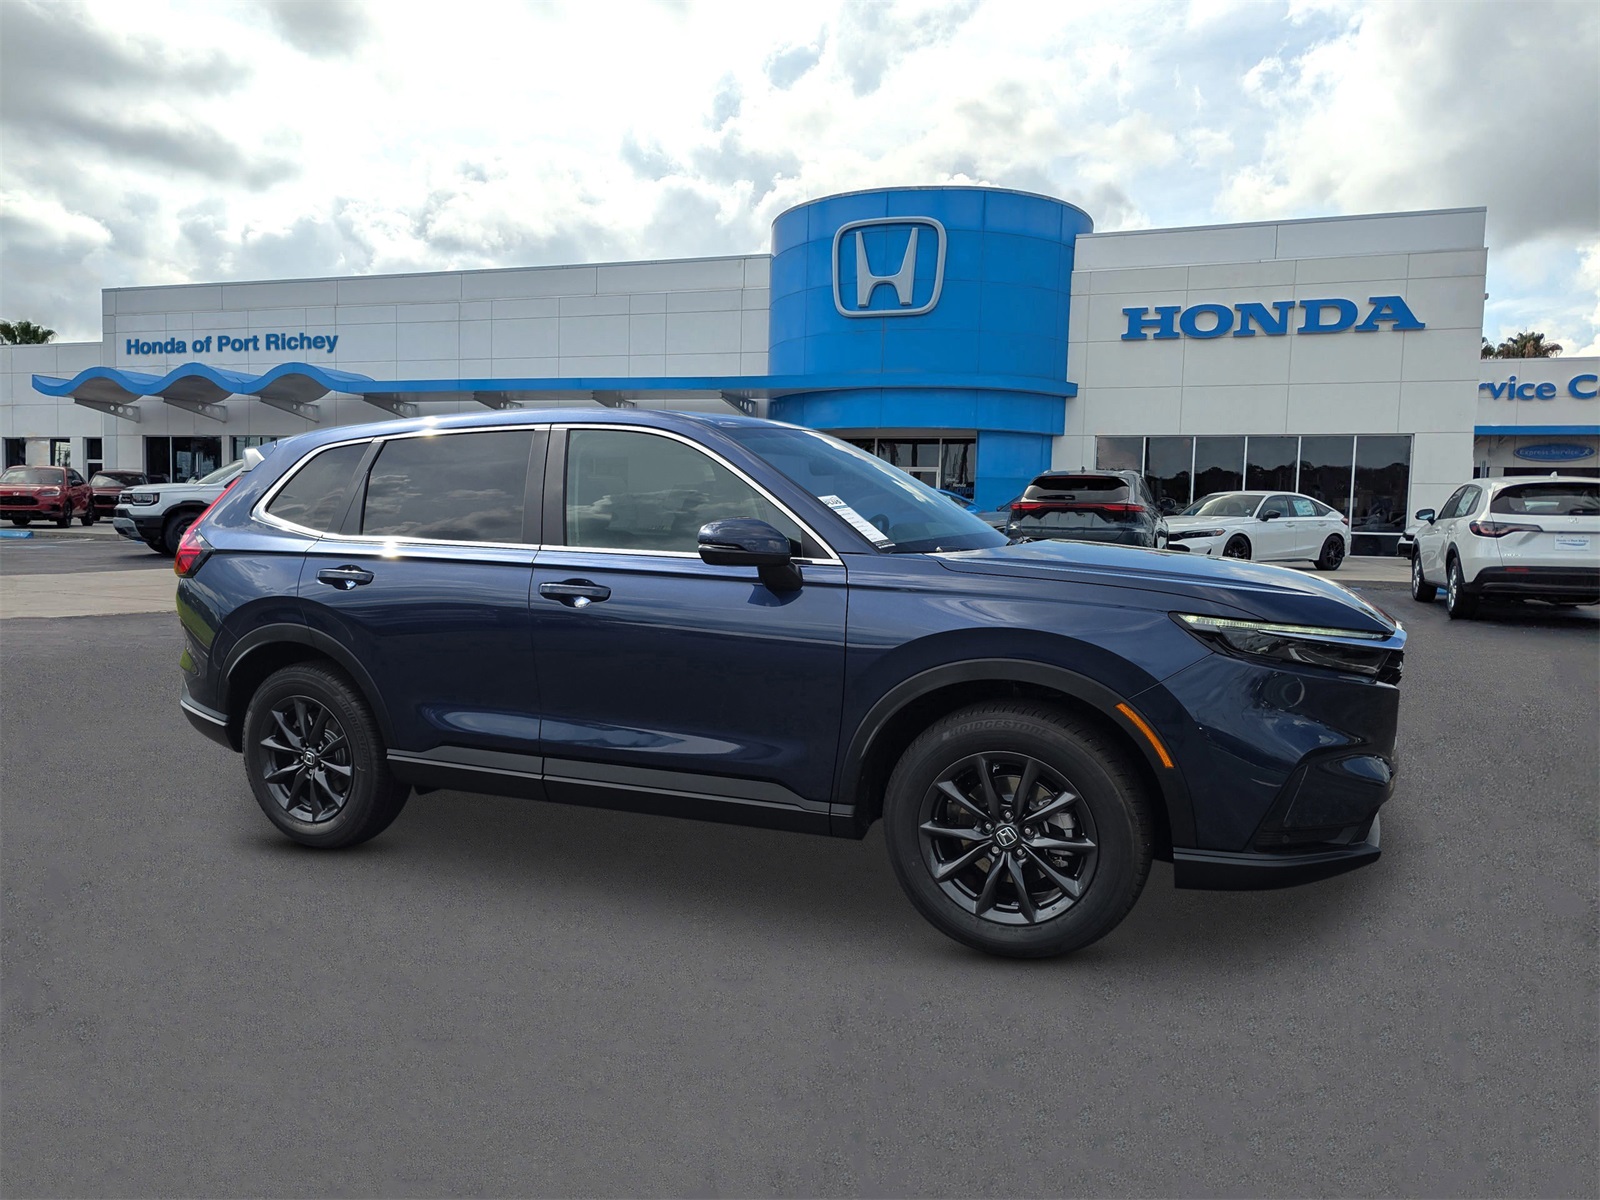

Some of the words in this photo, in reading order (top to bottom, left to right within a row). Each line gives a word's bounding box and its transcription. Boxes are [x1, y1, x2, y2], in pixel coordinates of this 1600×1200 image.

[1121, 295, 1425, 340] HONDA
[126, 337, 187, 355] Honda
[192, 335, 212, 353] of
[217, 335, 260, 353] Port
[265, 332, 339, 354] Richey
[1567, 374, 1600, 400] C
[1519, 449, 1549, 457] Express
[944, 719, 1049, 740] BRIDGESTONE
